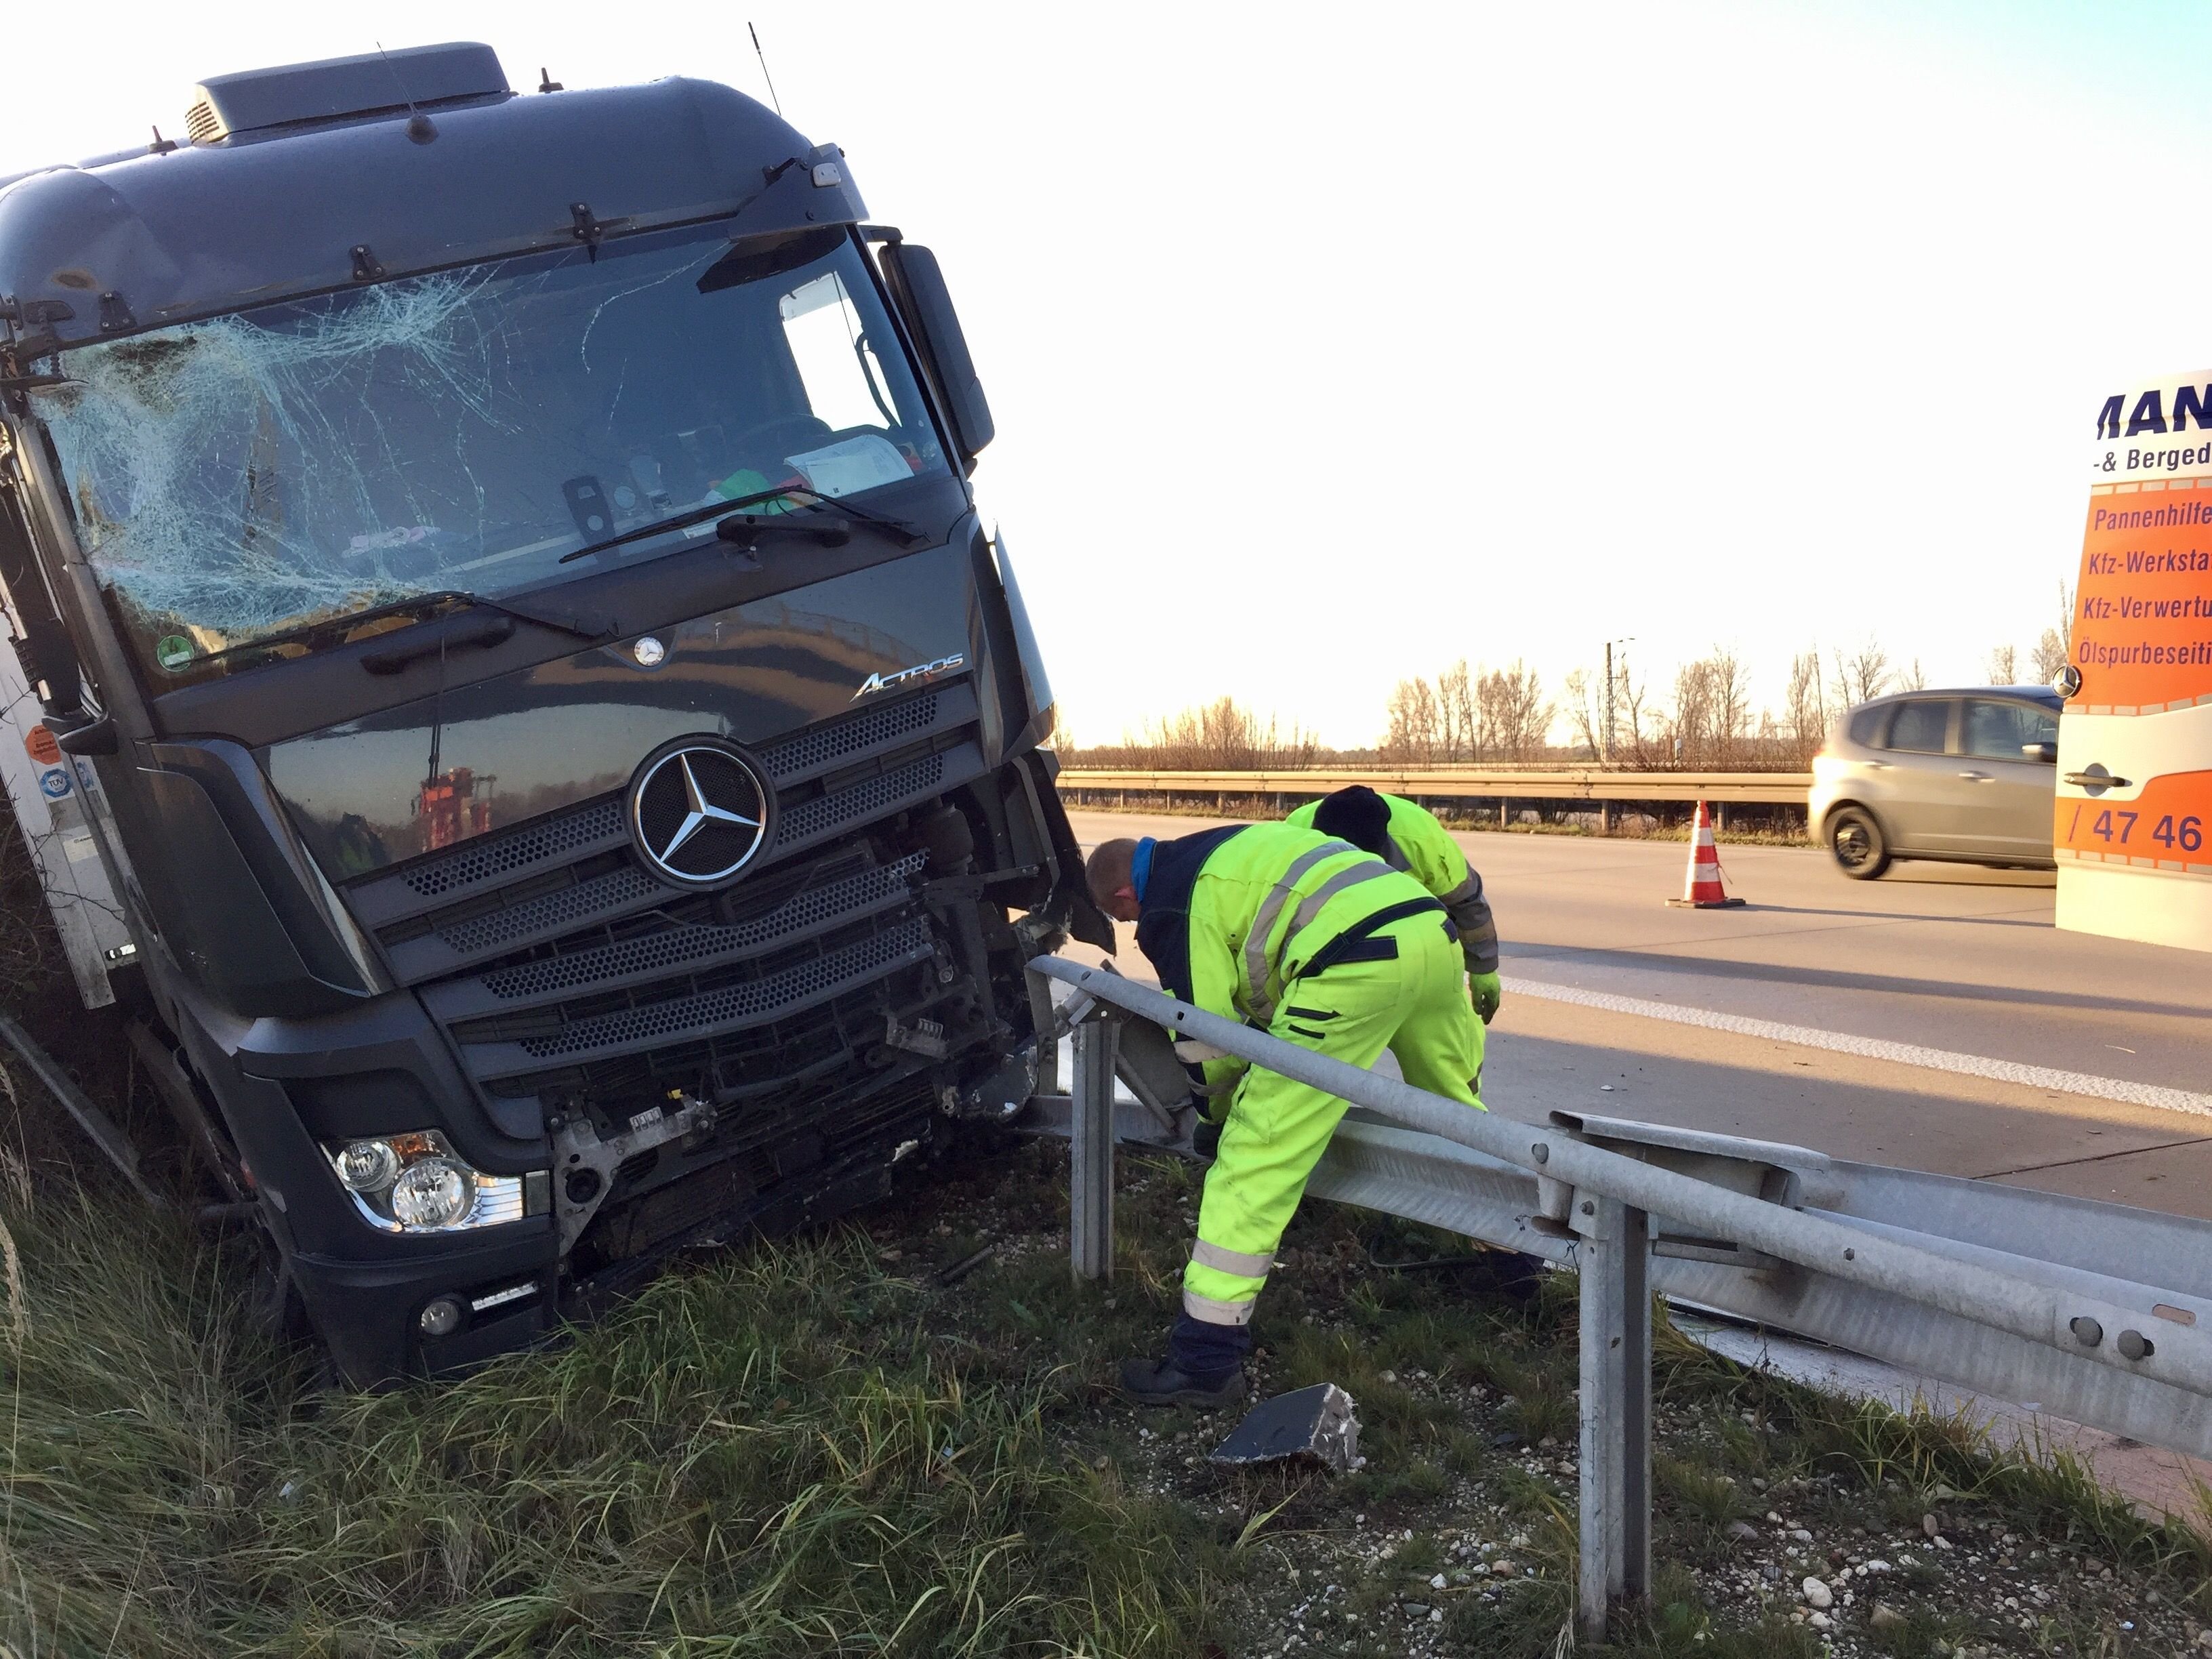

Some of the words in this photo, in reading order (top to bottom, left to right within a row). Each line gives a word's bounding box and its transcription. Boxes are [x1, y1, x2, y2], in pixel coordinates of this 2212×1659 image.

[2127, 442, 2211, 471] Berged
[2095, 501, 2212, 531] Pannenhilfe
[2089, 549, 2212, 575] Kfz-Werksta
[2083, 596, 2212, 619] Kfz-Verwertu
[2079, 636, 2212, 668] Ölspurbeseiti
[2093, 810, 2138, 844] 47
[2152, 815, 2202, 852] 46
